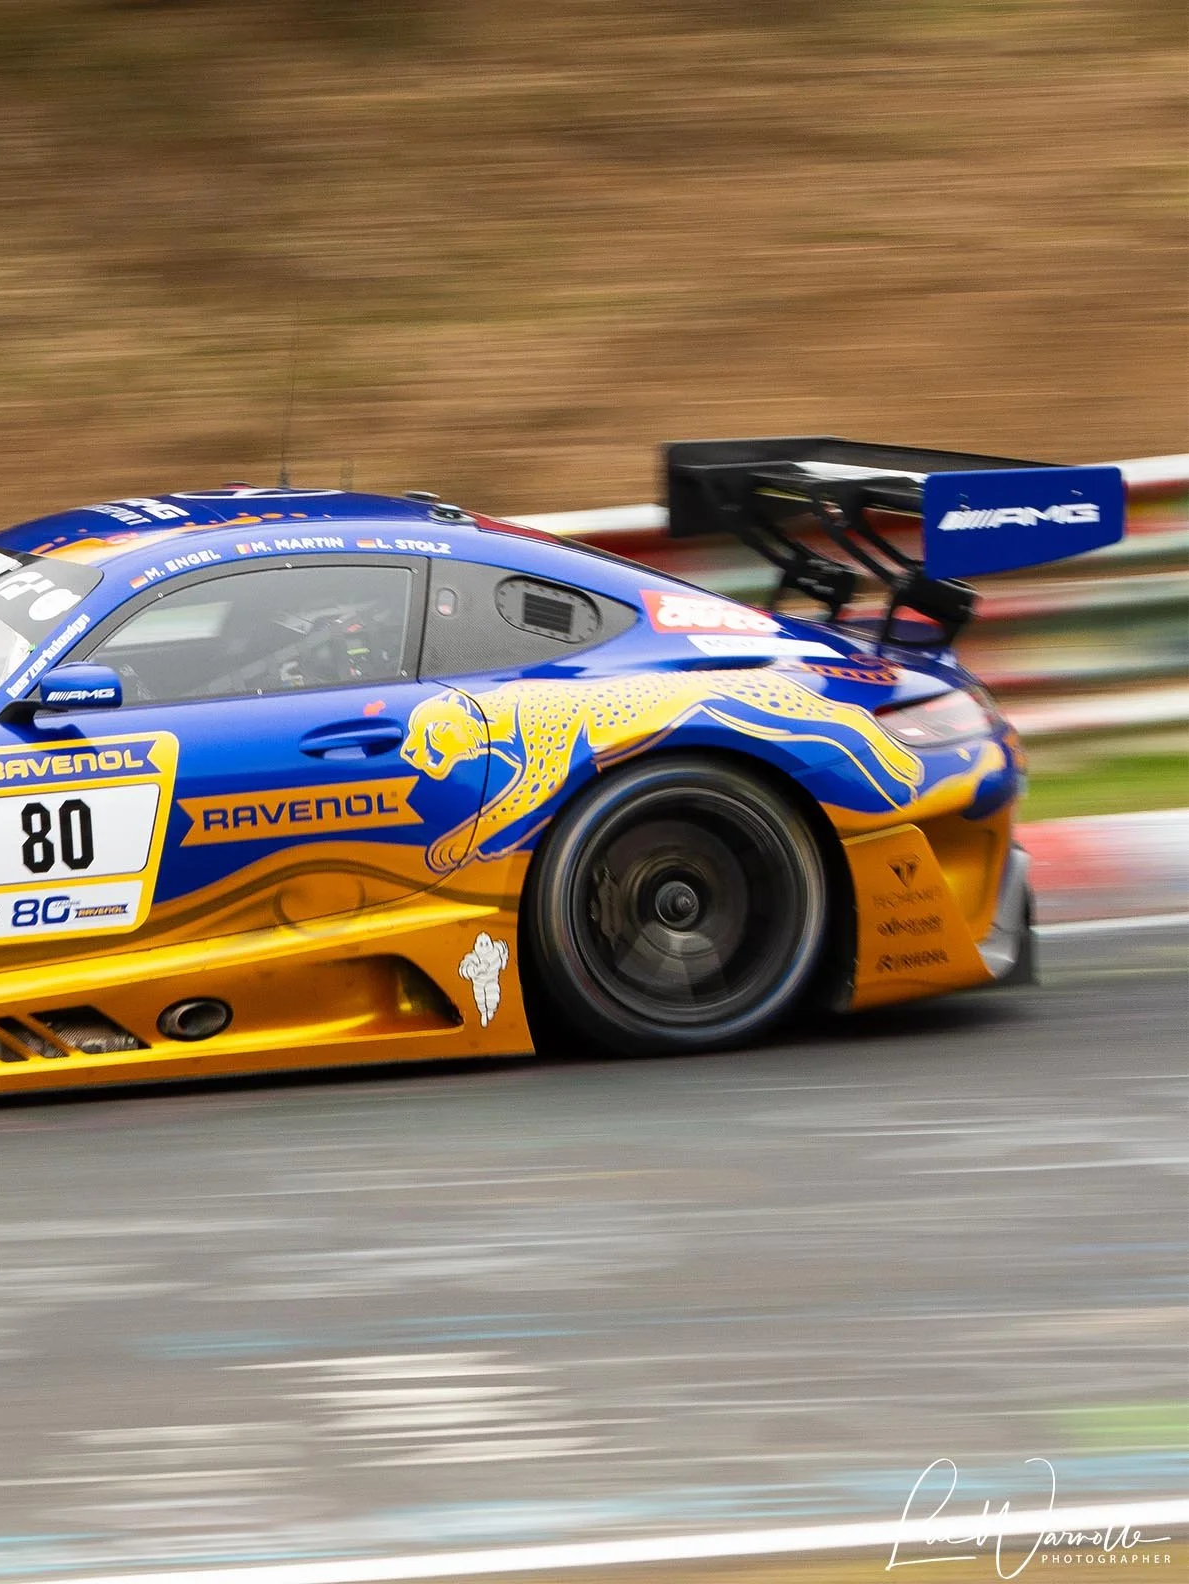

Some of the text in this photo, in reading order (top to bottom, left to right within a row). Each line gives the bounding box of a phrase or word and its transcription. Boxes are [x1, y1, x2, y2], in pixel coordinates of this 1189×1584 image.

[992, 503, 1101, 528] AMG
[251, 536, 345, 553] M. MARTIN
[376, 538, 453, 555] L. STOLZ
[144, 549, 222, 582] M. ENGEL
[65, 687, 116, 701] AMG
[202, 793, 399, 832] RAVENOL
[20, 798, 95, 875] 80
[11, 895, 71, 928] 80
